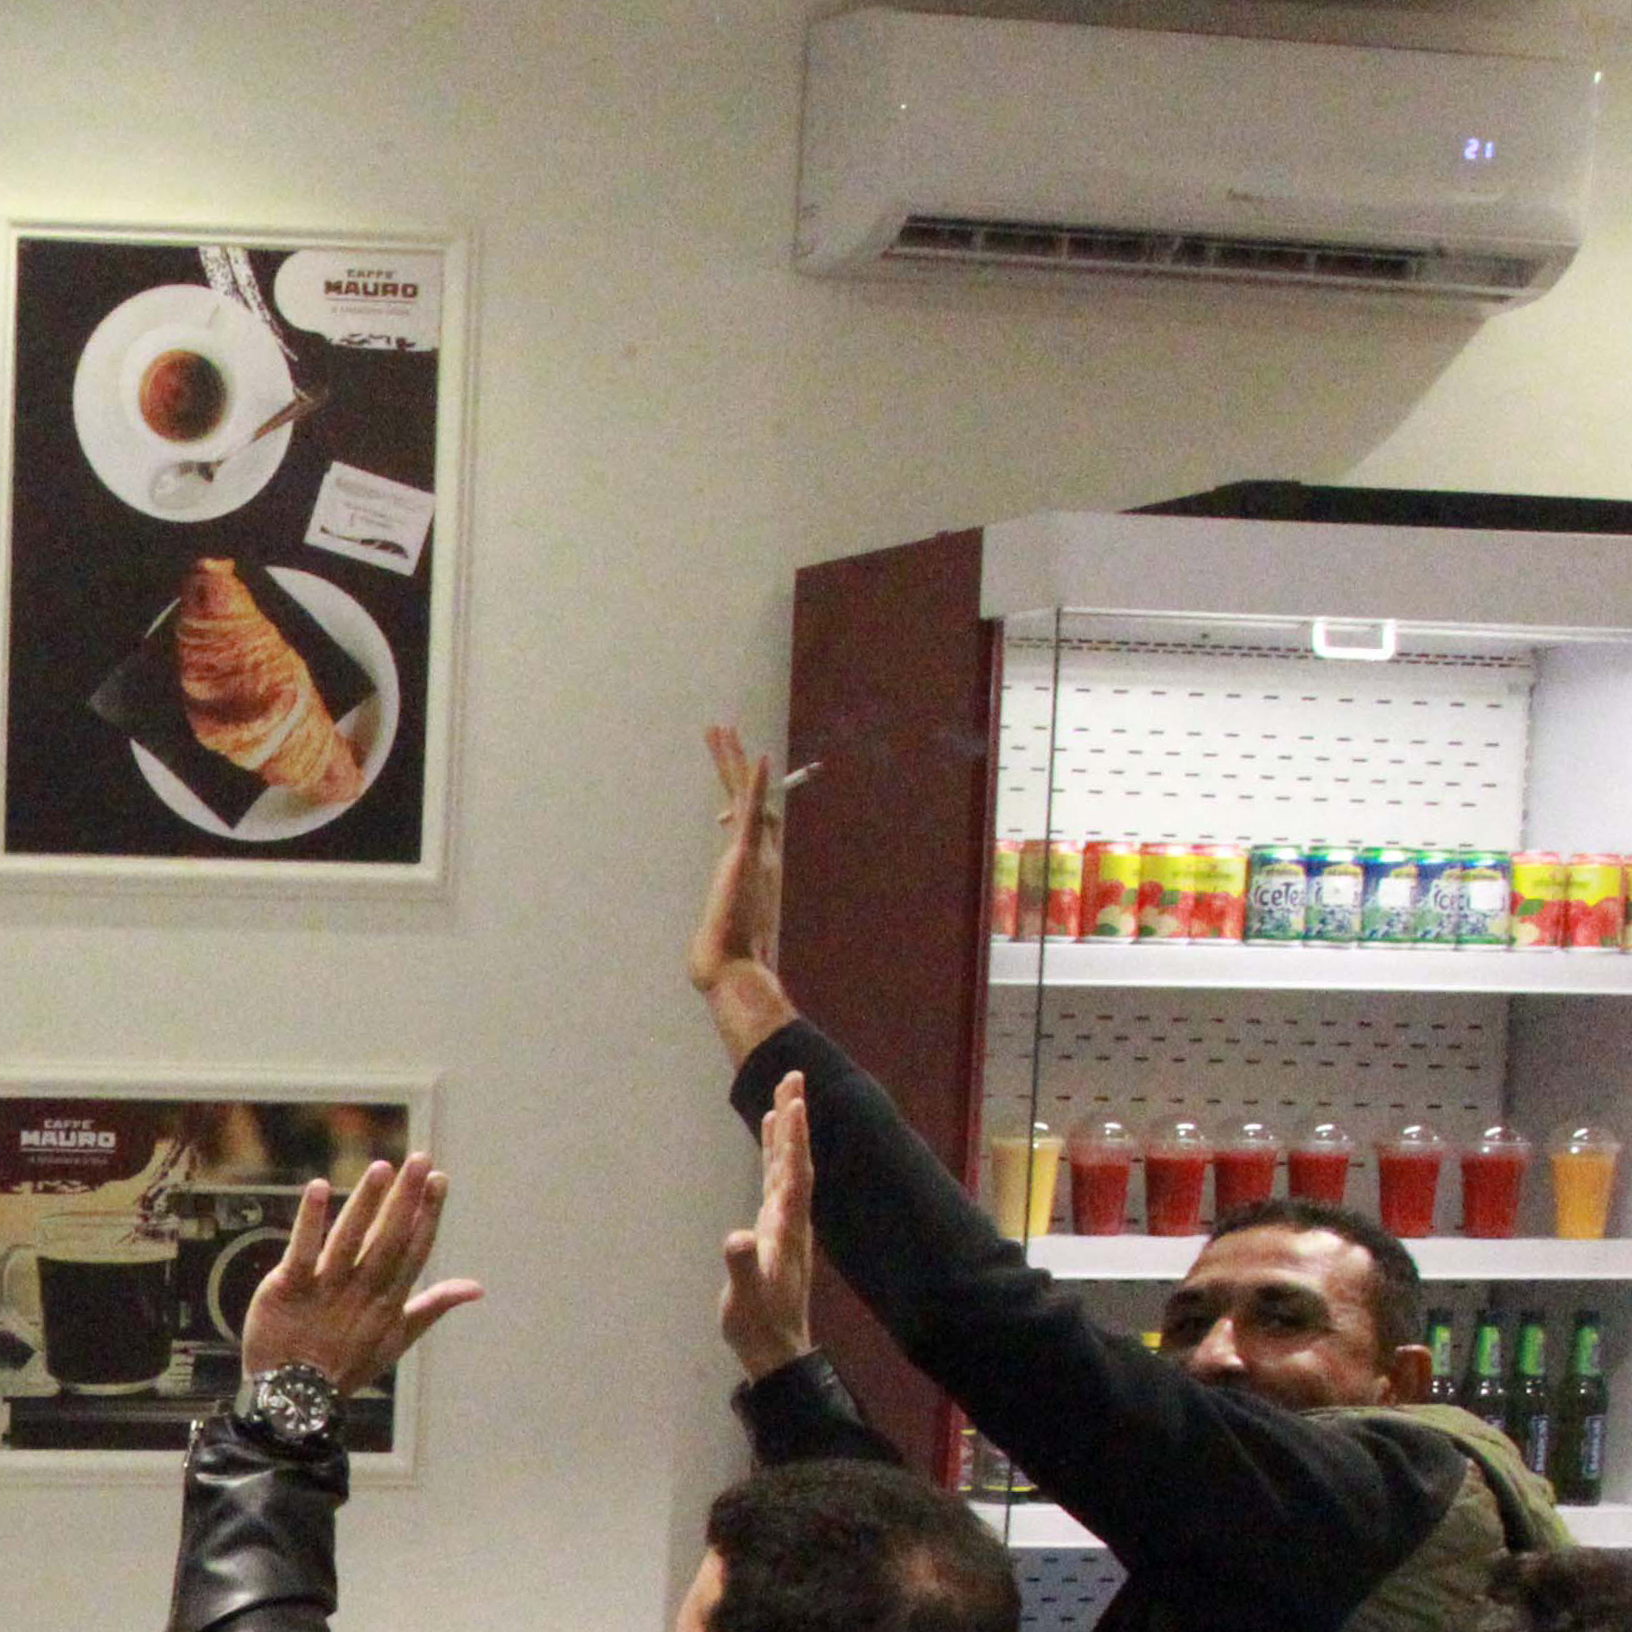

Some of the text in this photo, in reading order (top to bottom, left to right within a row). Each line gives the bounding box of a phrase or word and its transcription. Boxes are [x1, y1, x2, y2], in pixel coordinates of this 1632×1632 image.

[1464, 138, 1494, 159] 21
[324, 280, 418, 298] MAURO
[20, 1130, 116, 1148] MAURO
